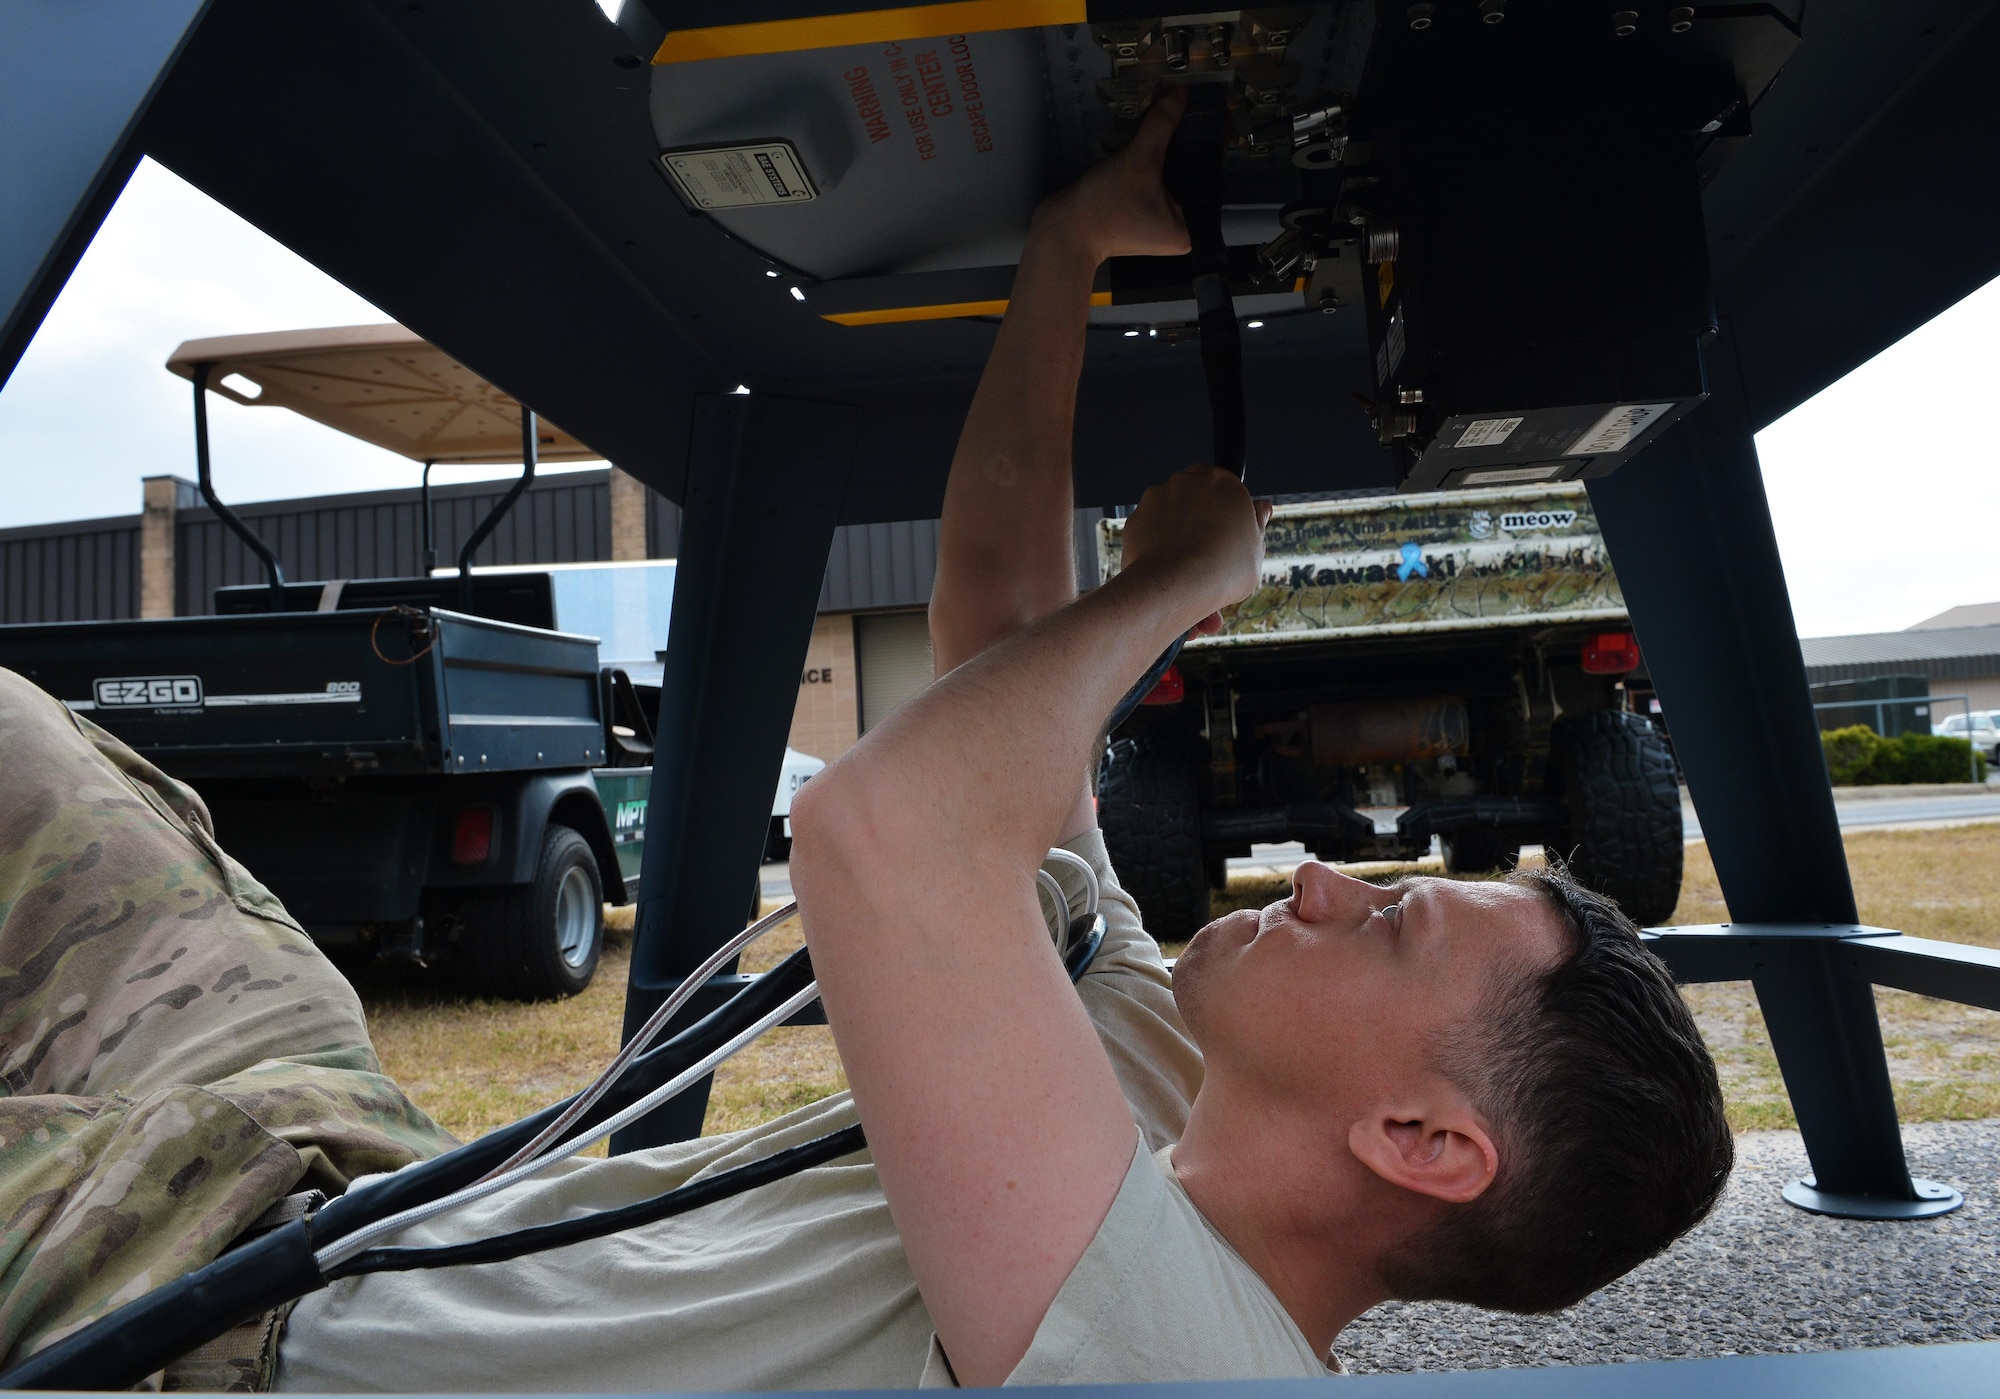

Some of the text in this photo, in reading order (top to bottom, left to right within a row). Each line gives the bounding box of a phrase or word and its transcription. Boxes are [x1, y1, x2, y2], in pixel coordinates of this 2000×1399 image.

[888, 57, 909, 73] IN
[893, 74, 919, 107] ONLY
[915, 49, 954, 118] CENTER
[956, 62, 981, 102] DOOR
[844, 66, 892, 144] WARNING
[905, 107, 929, 134] USE
[966, 102, 994, 154] ESCAPE
[915, 133, 937, 161] FOR
[755, 154, 788, 195] BAE SYSTEMS
[1611, 409, 1653, 427] DROP
[1584, 442, 1615, 452] DO
[1595, 428, 1632, 442] NOT
[1504, 513, 1573, 527] meow
[1291, 553, 1456, 590] Kawaski
[326, 681, 361, 693] 800
[615, 799, 648, 829] MPT
